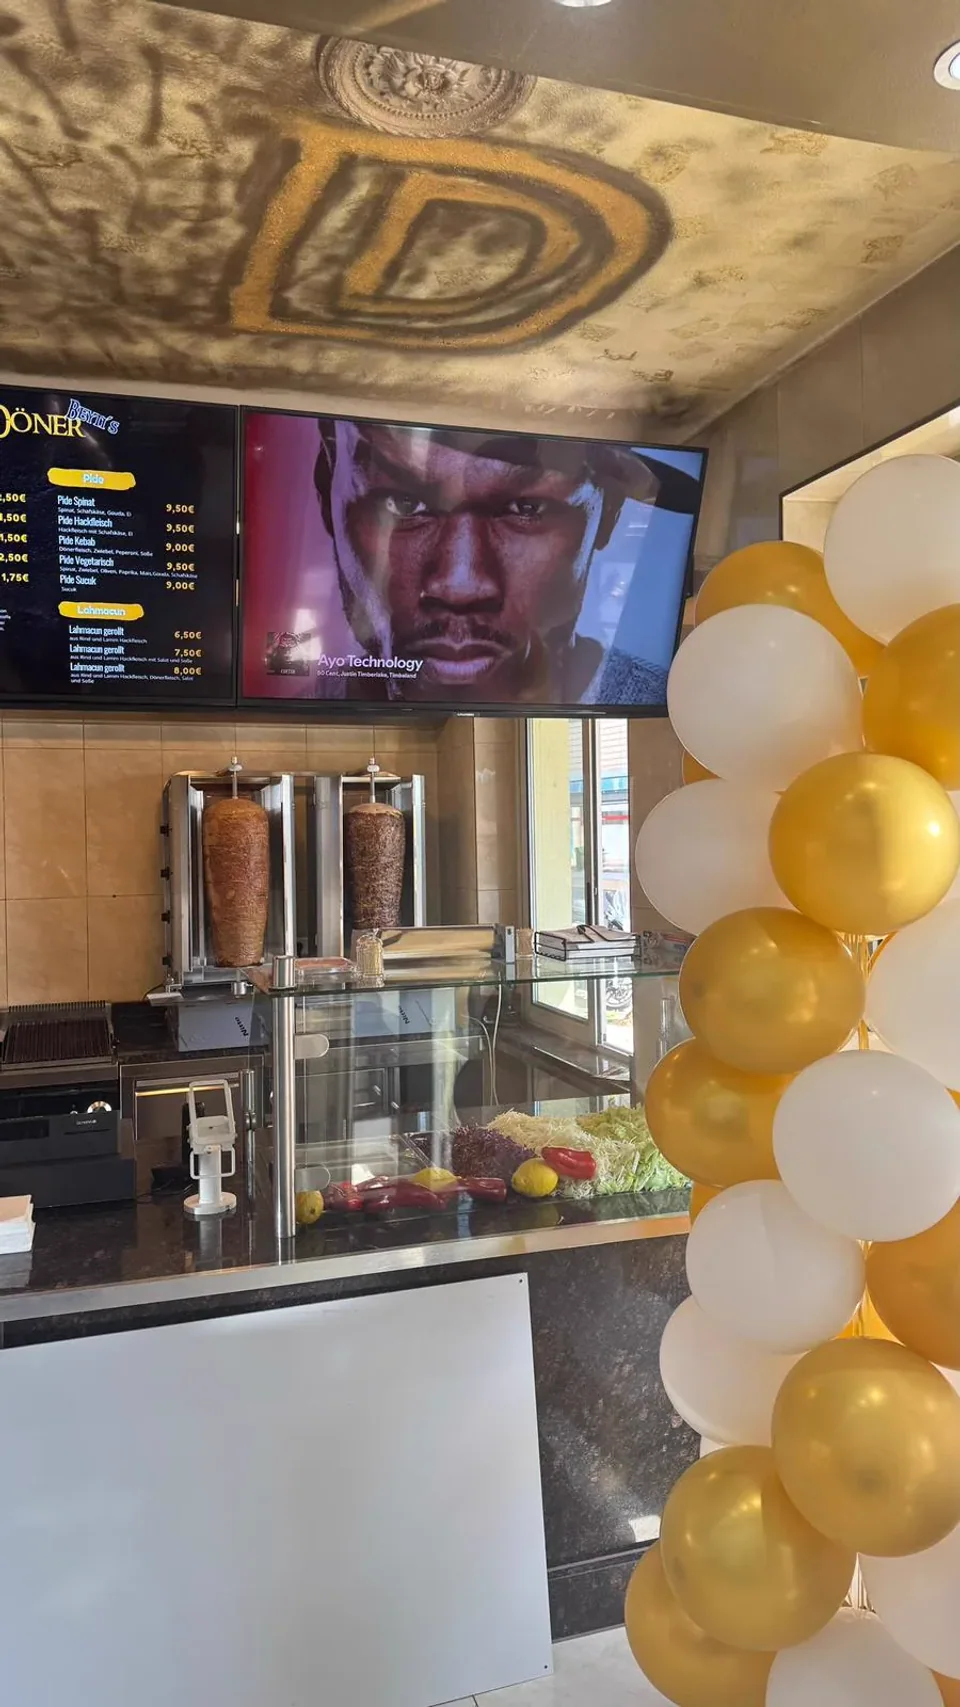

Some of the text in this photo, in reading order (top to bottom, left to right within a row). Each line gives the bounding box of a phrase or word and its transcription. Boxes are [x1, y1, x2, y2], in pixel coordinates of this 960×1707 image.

[83, 473, 104, 484] Pide
[57, 494, 95, 507] Pide Spinat
[166, 503, 195, 514] 9,50€
[57, 515, 113, 528] Pide Hackfleisch
[166, 523, 195, 533] 9,50€
[58, 535, 96, 547] Pide Kebab
[166, 542, 195, 552] 9,00€
[59, 554, 114, 567] Pide Vegetarisch
[167, 562, 195, 572] 9,50€
[1, 572, 29, 583] 1,75€
[60, 574, 97, 586] Pide Sucuk
[166, 581, 195, 591] 9,00€
[77, 605, 126, 616] Lahmacun
[69, 625, 124, 637] Lahmacun gerollt
[174, 630, 202, 640] 6,50€
[70, 643, 125, 656] Lahmacun gerollt
[174, 648, 202, 658] 7,50€
[71, 662, 125, 674] Lahmacun gerollt
[317, 654, 424, 672] Ayo Technology
[173, 666, 202, 676] 8,00€
